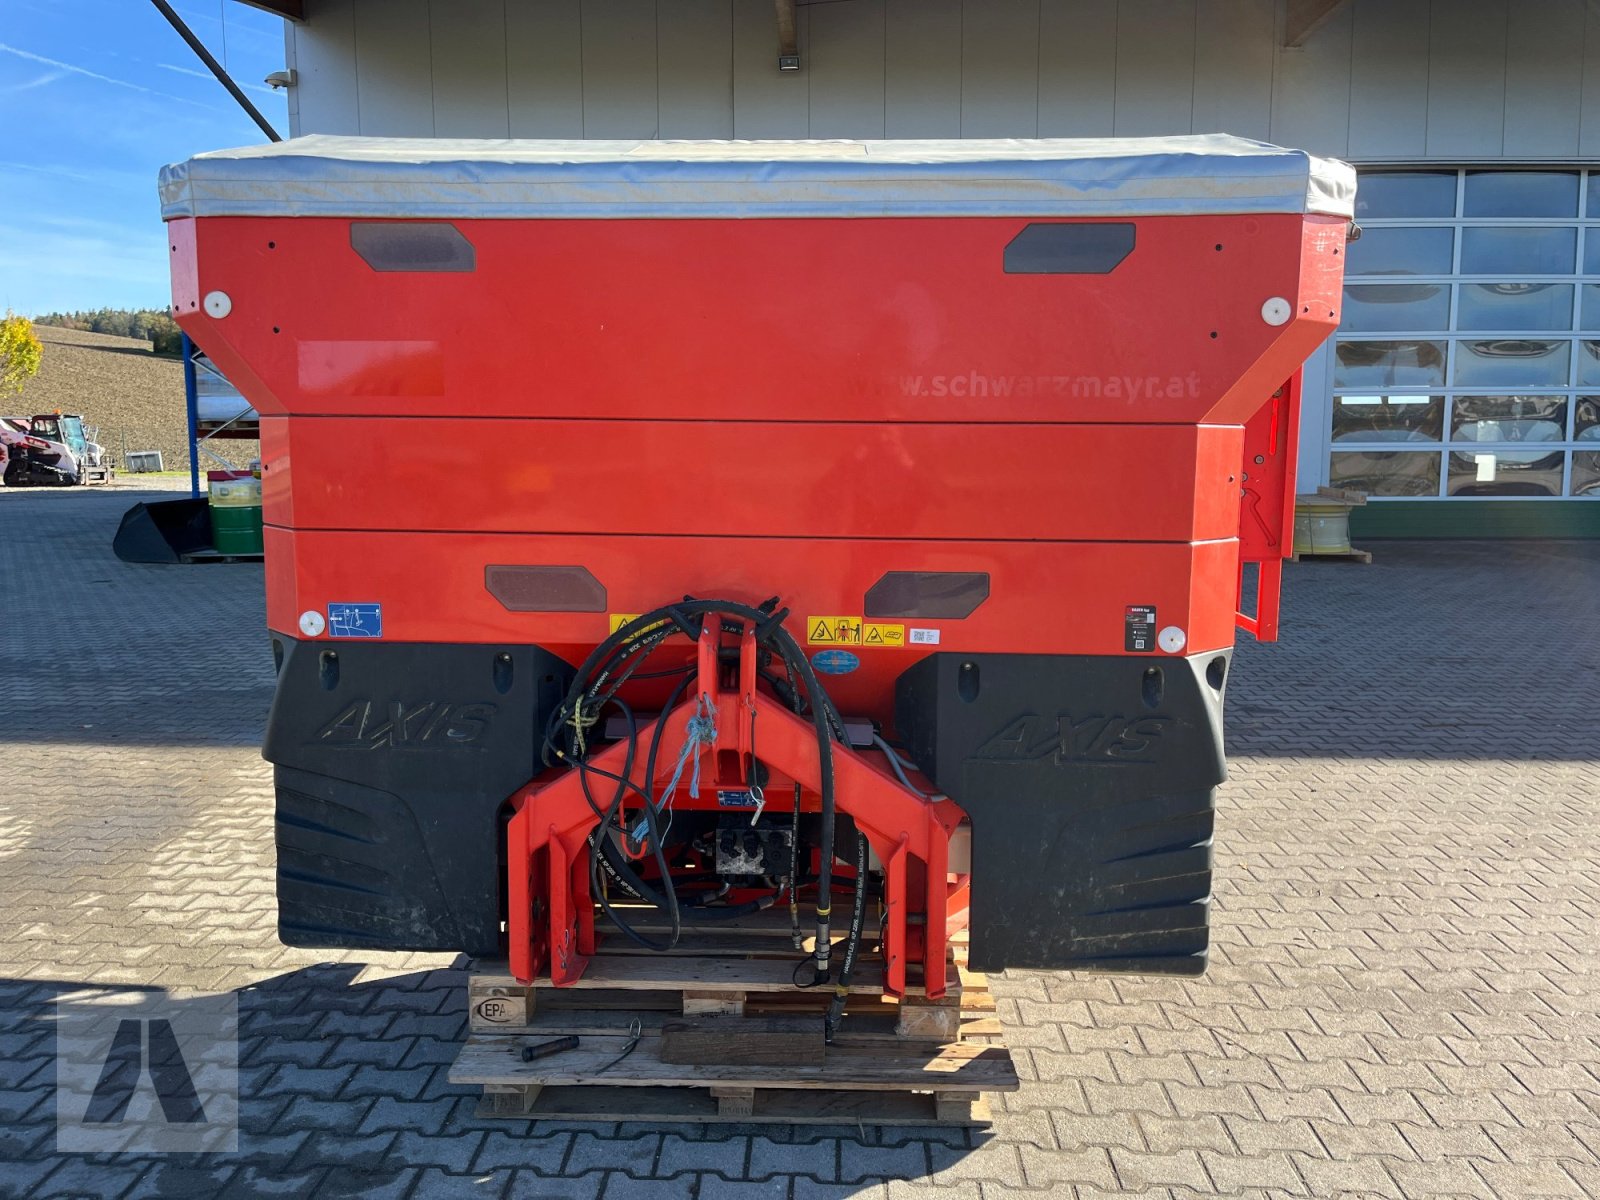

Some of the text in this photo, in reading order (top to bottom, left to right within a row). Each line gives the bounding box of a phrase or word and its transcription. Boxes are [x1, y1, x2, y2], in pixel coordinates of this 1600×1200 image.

[313, 700, 497, 750] AXIS
[974, 713, 1174, 763] AXIS
[485, 1003, 513, 1017] EPA
